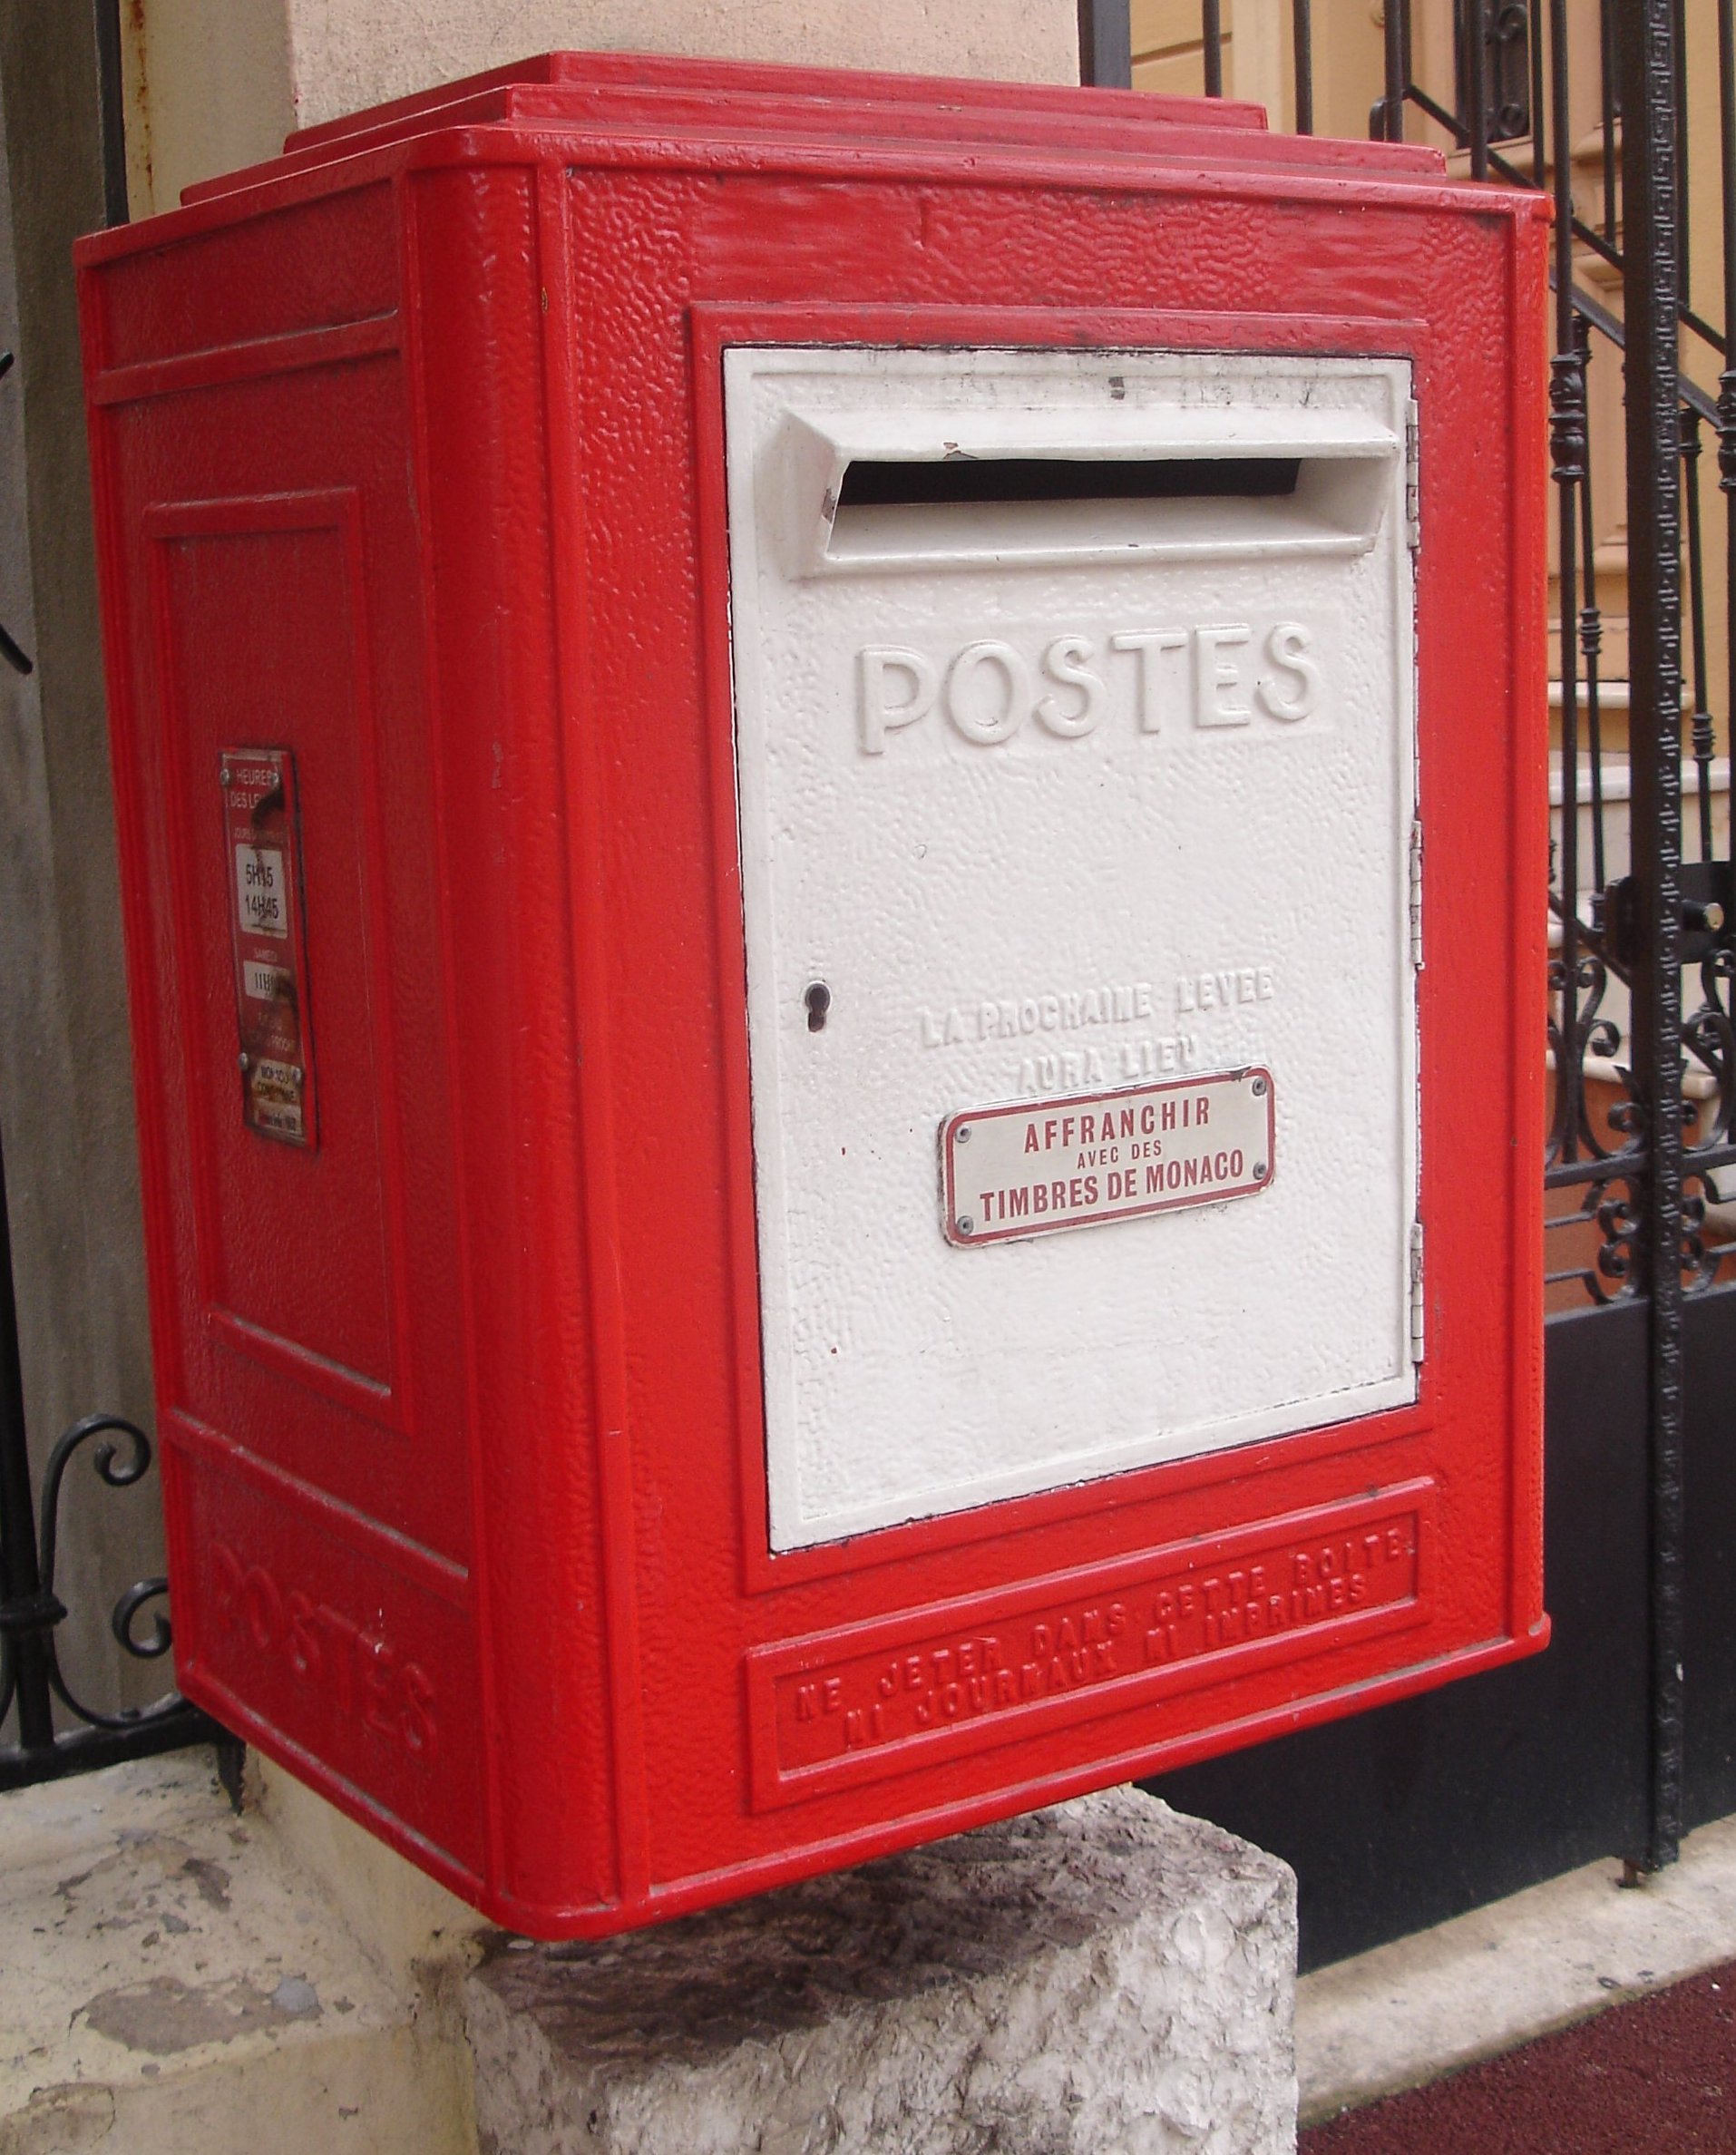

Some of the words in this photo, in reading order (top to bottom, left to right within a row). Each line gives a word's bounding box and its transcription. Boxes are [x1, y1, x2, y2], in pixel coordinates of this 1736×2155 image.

[855, 622, 1322, 755] POSTES
[916, 1005, 964, 1048] LA
[978, 982, 1152, 1042] PROCHAINE
[1177, 967, 1273, 1013] LEVEE
[1018, 1048, 1104, 1091] AURA
[1118, 1035, 1197, 1078] LIEU
[1024, 1097, 1211, 1153] AFFRANCHIR
[1078, 1141, 1119, 1170] AVEC
[1131, 1139, 1163, 1161] DES
[980, 1175, 1098, 1223] TIMBRES
[1107, 1168, 1137, 1201] DE
[1146, 1149, 1243, 1195] MONACO
[208, 1540, 437, 1752] POSTES
[796, 1677, 842, 1721] NE
[878, 1636, 1001, 1699] JETER
[1030, 1603, 1126, 1659] DANS
[1156, 1566, 1264, 1625] CETTE
[1293, 1527, 1401, 1586] BOITE
[844, 1702, 885, 1750] NI
[916, 1640, 1117, 1726] JOURNAUX
[1145, 1624, 1177, 1662] NI
[1204, 1572, 1365, 1649] IMPRIMES
